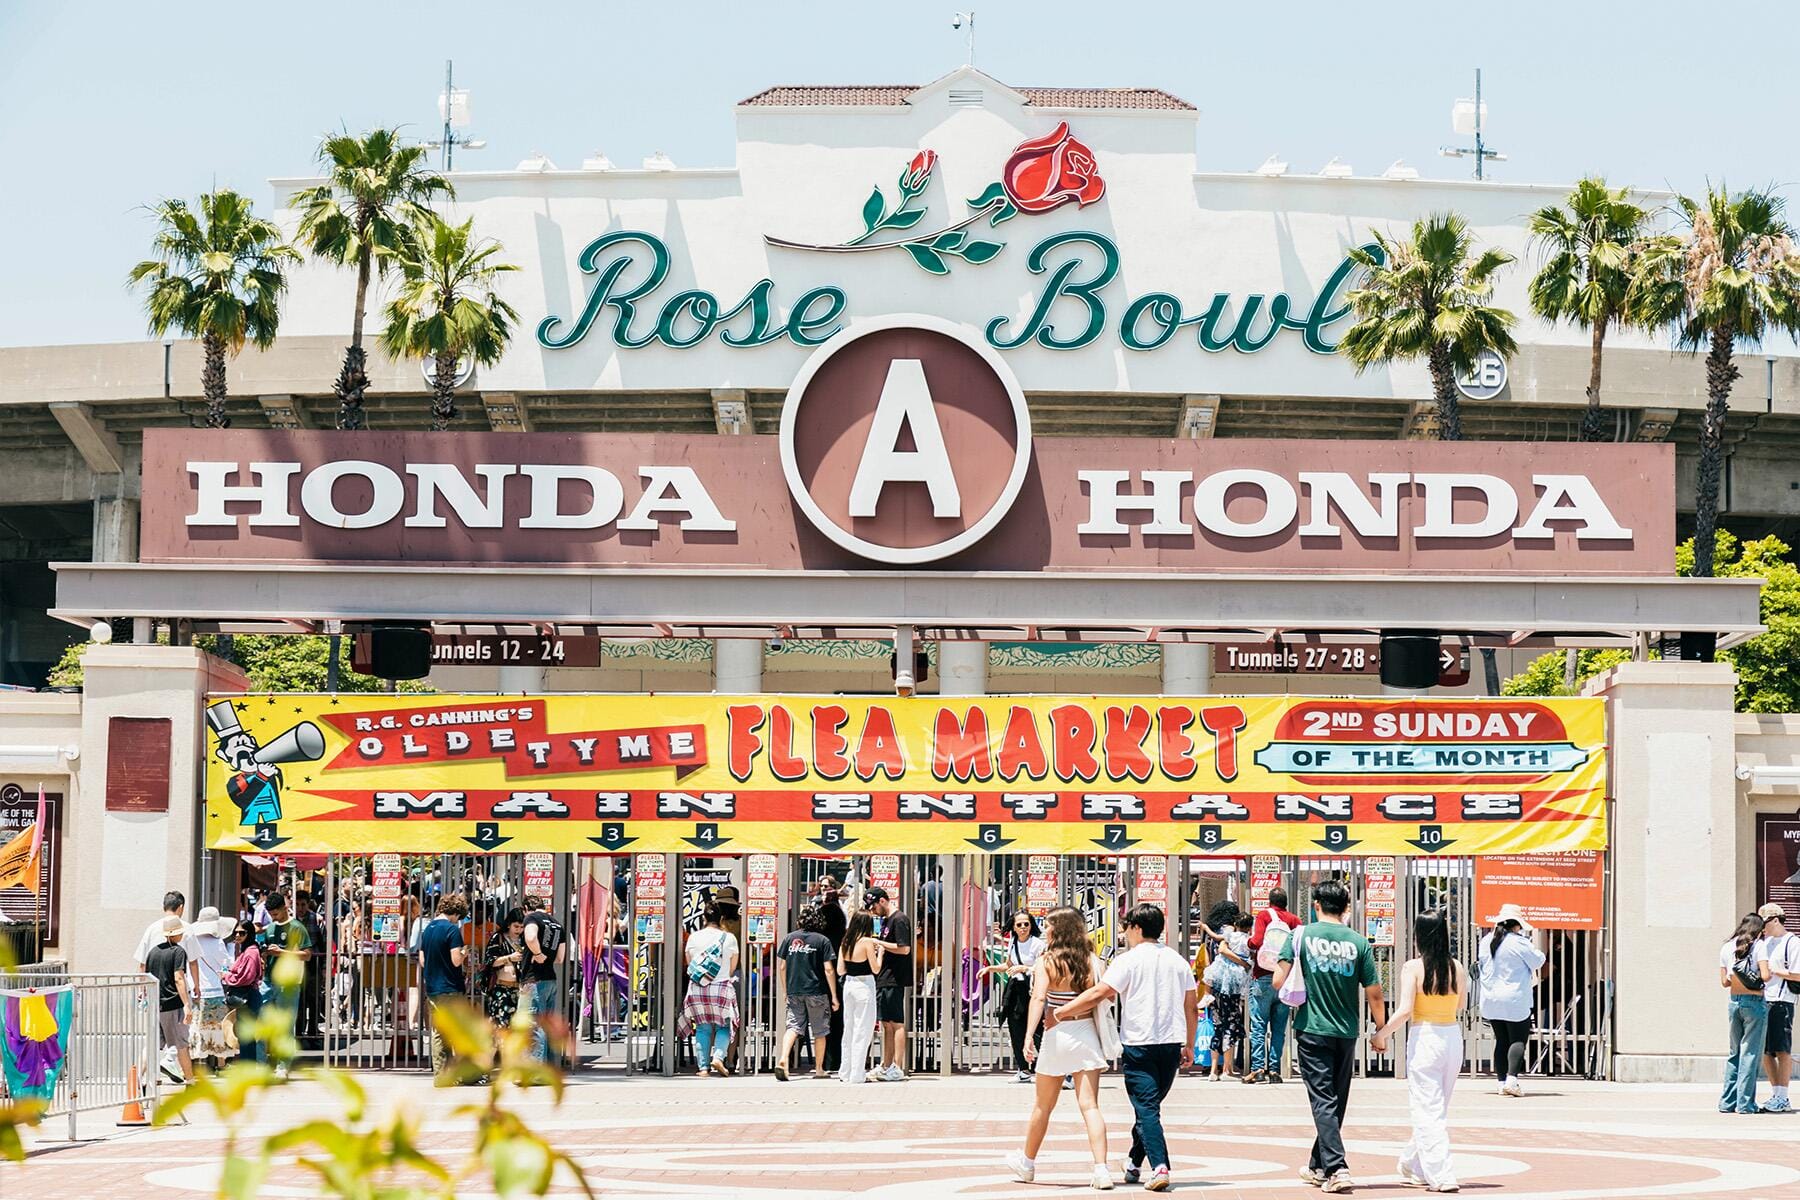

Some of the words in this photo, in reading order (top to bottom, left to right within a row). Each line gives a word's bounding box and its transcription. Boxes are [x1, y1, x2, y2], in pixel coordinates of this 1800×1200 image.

[538, 229, 847, 350] Rose
[984, 229, 1387, 354] Bowl
[849, 358, 962, 519] A
[185, 460, 737, 531] HONDA
[1077, 469, 1634, 540] HONDA
[433, 640, 491, 660] unnels
[500, 640, 520, 660] 12
[540, 640, 565, 661] 24
[1227, 647, 1298, 668] Tunnels
[1305, 648, 1328, 668] 27
[1342, 648, 1365, 668] 28
[356, 716, 402, 731] R.G.
[410, 707, 533, 727] CANNING'S
[1303, 711, 1363, 737] 2ND
[1373, 712, 1538, 738] SUNDAY
[727, 704, 906, 782] FLEA
[932, 704, 1247, 782] MARKET
[1292, 750, 1332, 767] OF
[1351, 750, 1413, 767] THE
[1435, 749, 1551, 767] MONTH
[22, 809, 34, 818] THE
[374, 791, 737, 819] MAIN
[811, 792, 1523, 821] ENTRANCE
[261, 828, 271, 842] 1
[482, 828, 493, 841] 2
[607, 828, 618, 841] 3
[701, 828, 713, 841] 4
[827, 829, 838, 842] 5
[984, 829, 995, 842] 6
[1111, 829, 1121, 843] 7
[1204, 829, 1216, 843] 8
[1331, 831, 1342, 844] 9
[1420, 831, 1441, 844] 10
